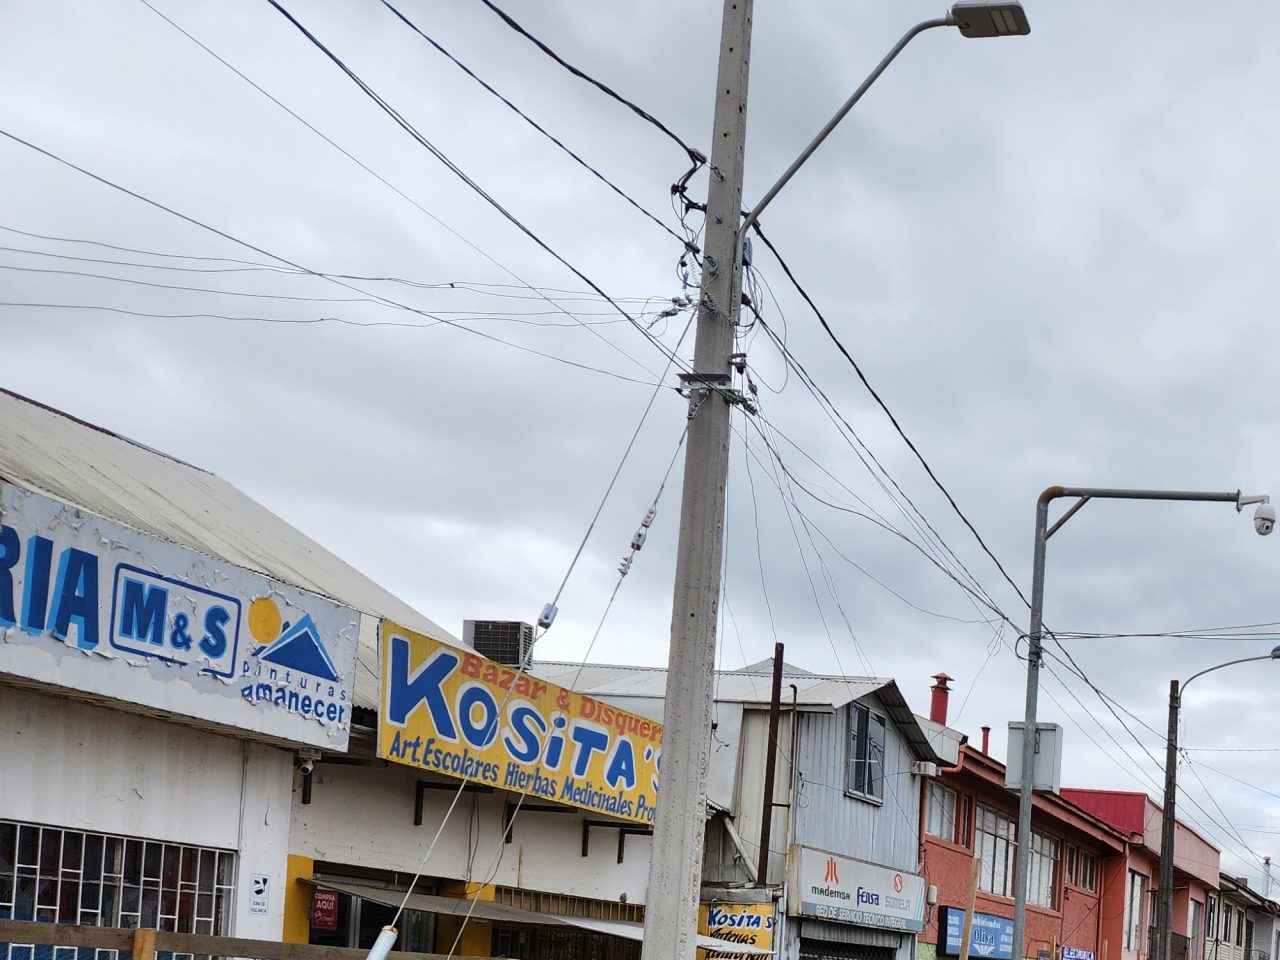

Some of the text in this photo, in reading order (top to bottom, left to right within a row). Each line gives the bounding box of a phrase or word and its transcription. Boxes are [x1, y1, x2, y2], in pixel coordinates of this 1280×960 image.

[242, 660, 346, 701] pinturas
[460, 652, 547, 700] Bazar
[556, 687, 570, 714] &
[241, 683, 345, 723] amanecer
[503, 761, 557, 801] Hierbas
[560, 775, 633, 817] Medicinales
[314, 892, 336, 901] COMPRA
[811, 885, 851, 901] mademsa
[815, 905, 828, 916] RED
[828, 907, 838, 917] DE
[838, 908, 863, 922] SERVICIO
[885, 916, 907, 929] INTEGRAL
[709, 928, 758, 946] Antenas
[974, 928, 995, 945] Oliva
